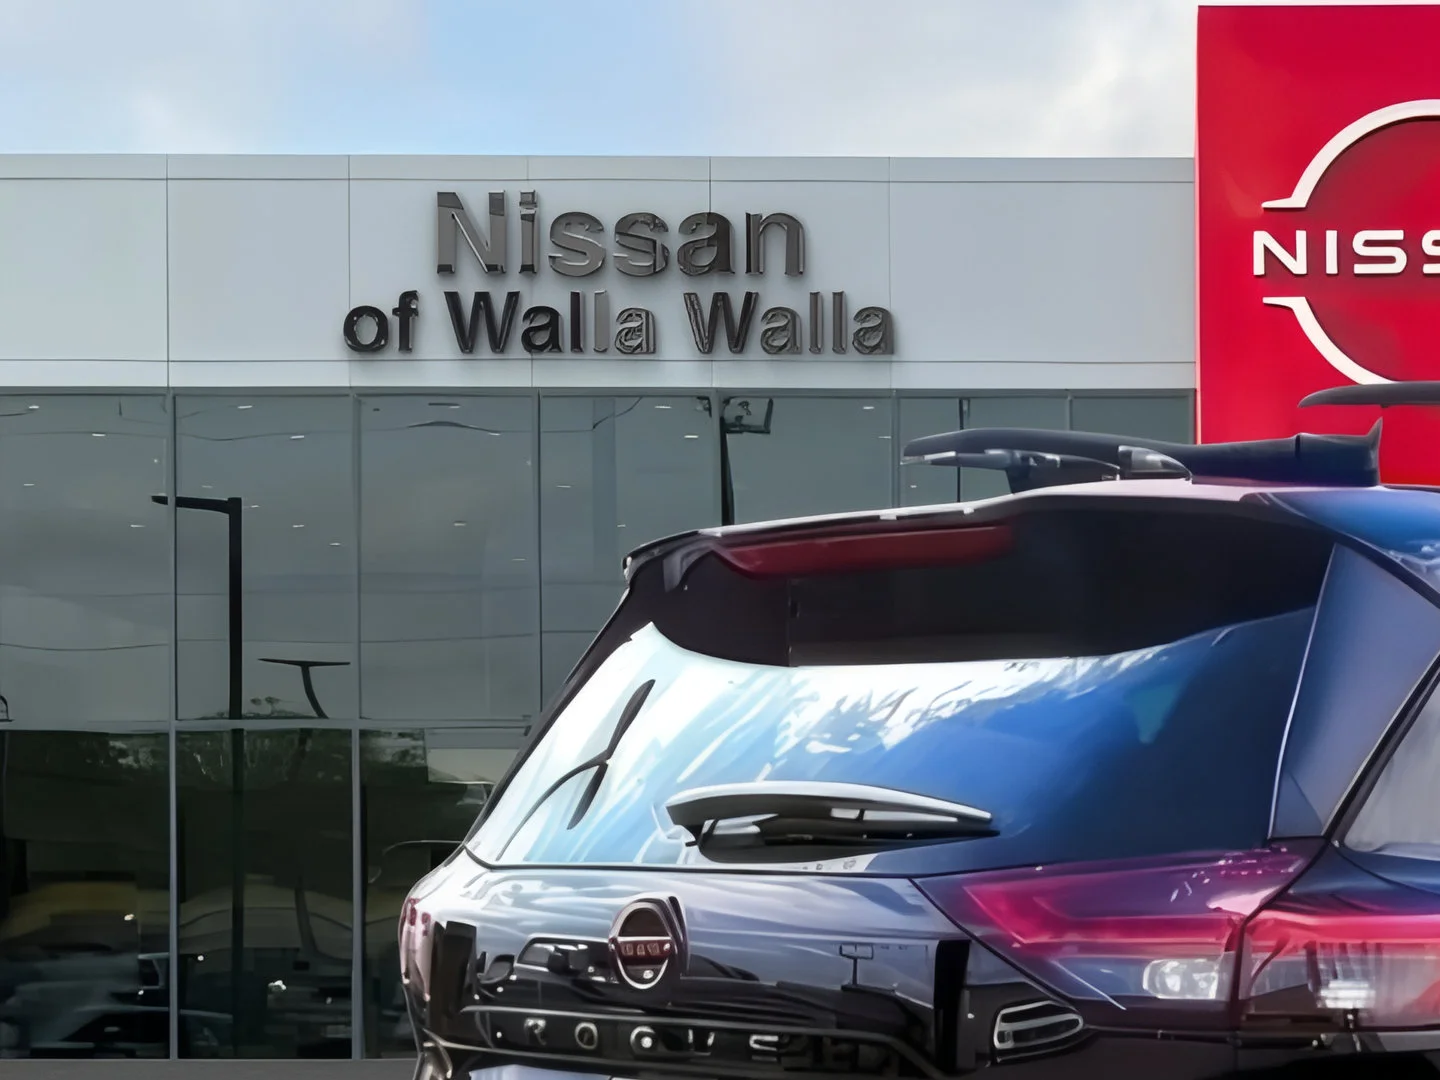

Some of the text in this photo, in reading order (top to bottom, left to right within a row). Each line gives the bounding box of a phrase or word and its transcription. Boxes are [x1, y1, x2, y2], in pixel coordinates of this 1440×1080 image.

[435, 189, 806, 278] Nissan
[342, 289, 896, 355] of Walla Walla
